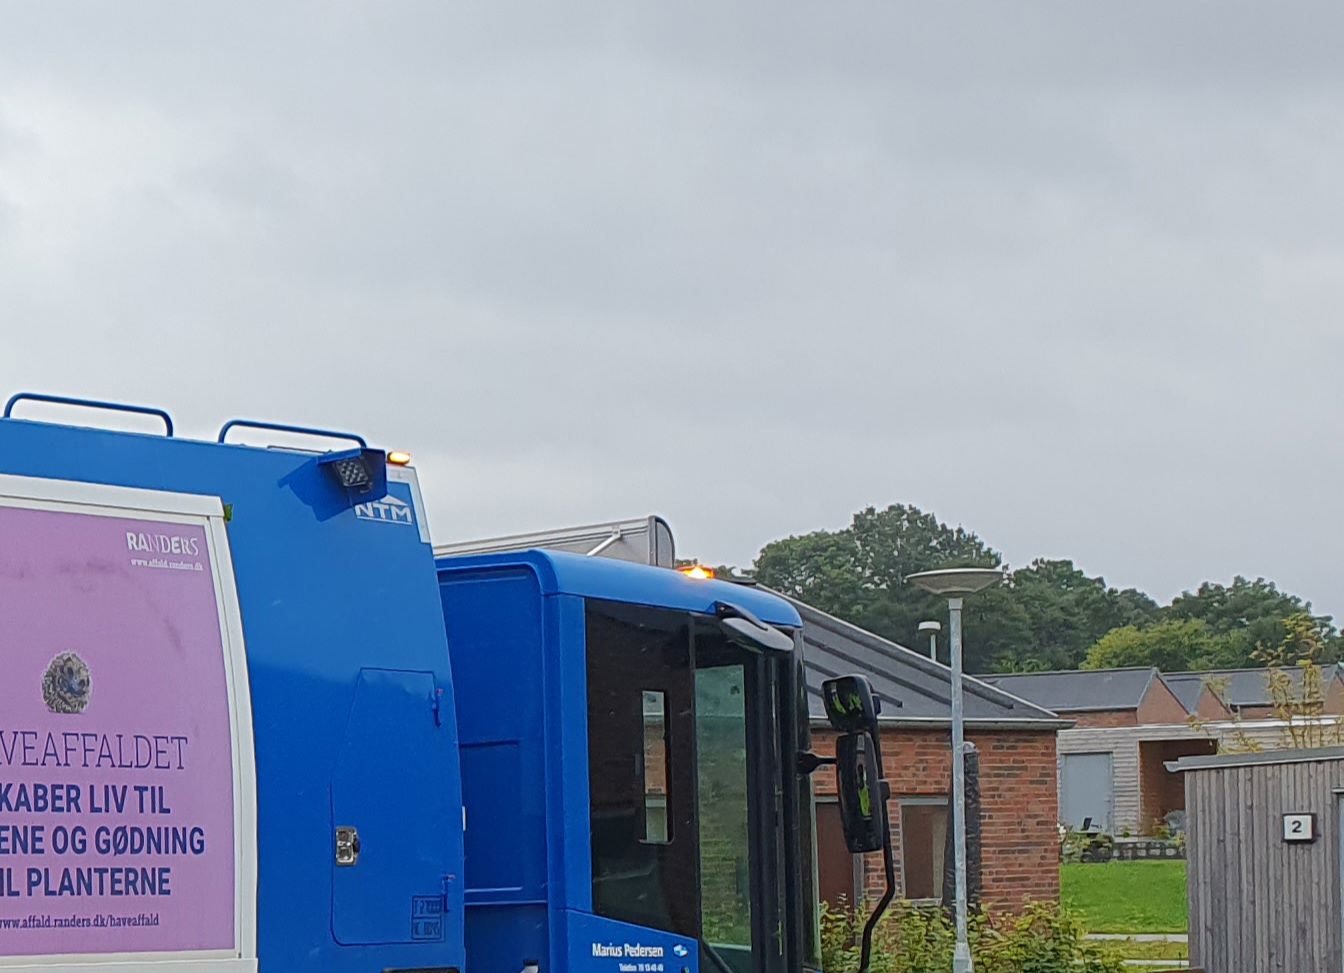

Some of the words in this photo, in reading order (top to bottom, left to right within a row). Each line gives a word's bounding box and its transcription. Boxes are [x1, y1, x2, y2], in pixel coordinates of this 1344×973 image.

[354, 501, 413, 522] NTM
[126, 532, 199, 556] RANDERS
[89, 784, 127, 813] LIV
[134, 785, 171, 814] TIL
[1291, 820, 1302, 833] 2
[52, 825, 87, 855] OG
[95, 825, 205, 856] GØDNING
[26, 867, 171, 897] PLANTERNE
[592, 942, 622, 957] Marius
[624, 942, 663, 957] Pedersen
